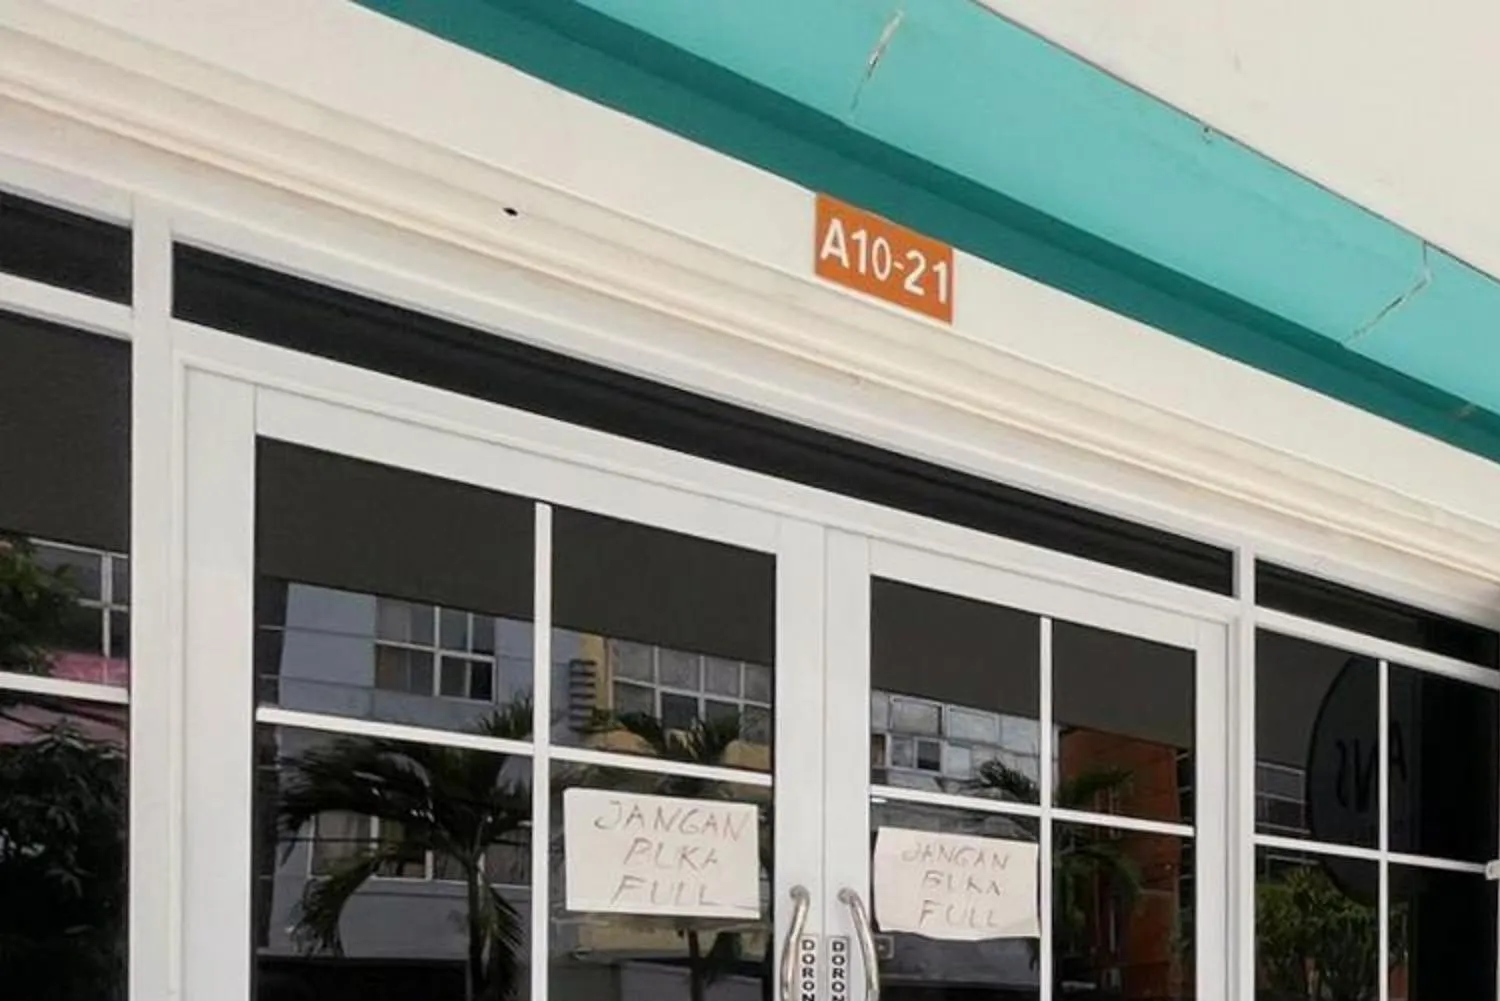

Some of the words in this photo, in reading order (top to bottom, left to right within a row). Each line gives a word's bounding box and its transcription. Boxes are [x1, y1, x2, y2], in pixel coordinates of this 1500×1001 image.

[819, 217, 948, 305] A10-21
[593, 800, 748, 842] JANGAN
[611, 874, 723, 907] FULL
